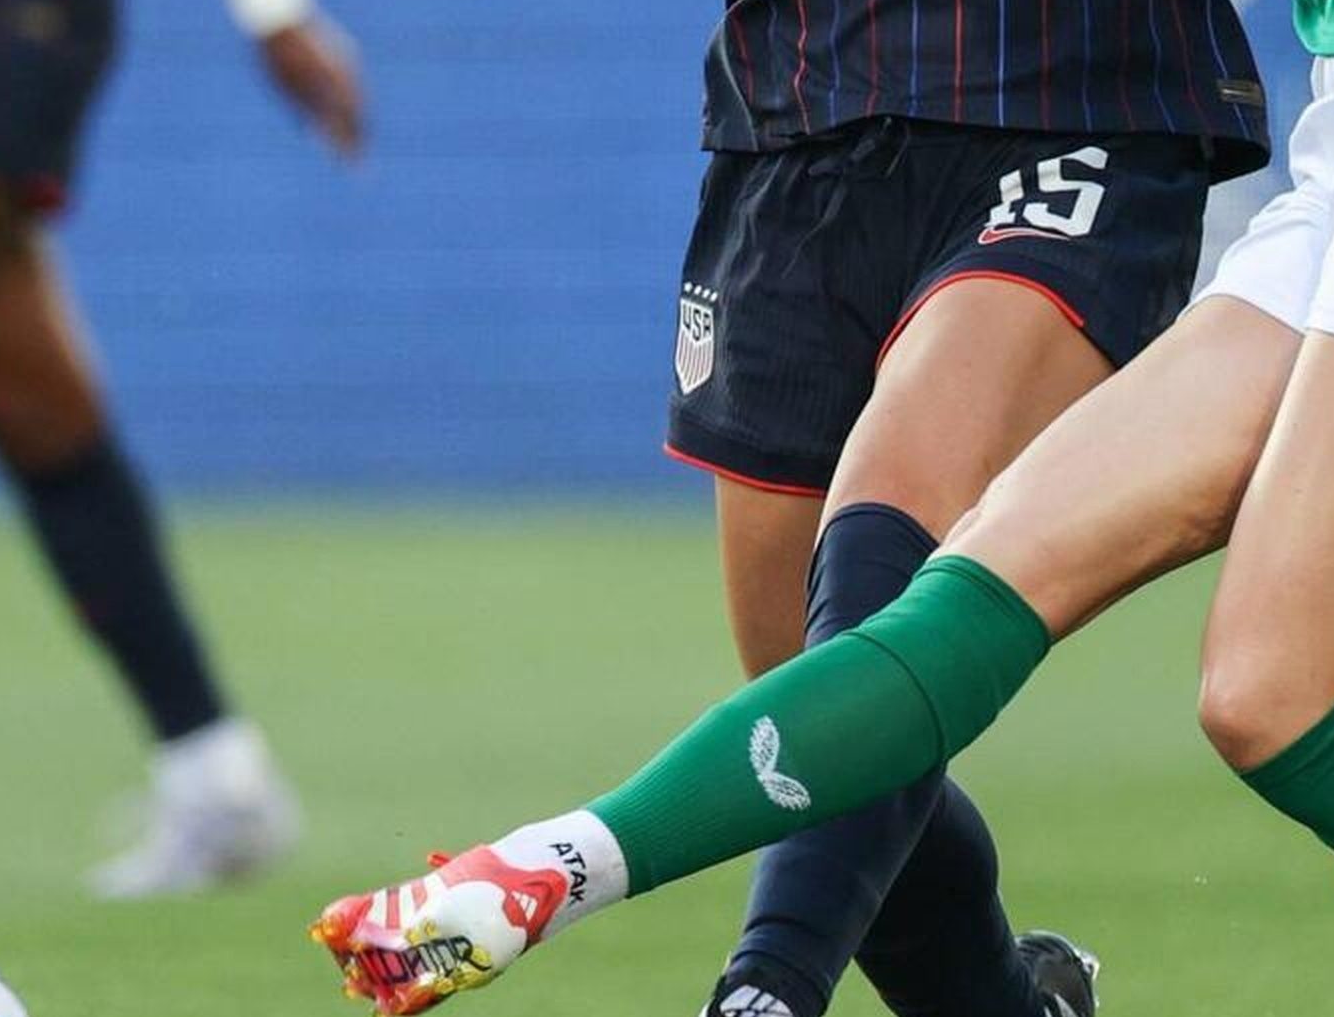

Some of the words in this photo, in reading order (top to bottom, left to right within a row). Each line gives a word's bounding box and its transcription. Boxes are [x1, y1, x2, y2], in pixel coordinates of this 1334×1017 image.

[984, 146, 1108, 236] 15
[683, 303, 712, 341] USA
[548, 841, 588, 905] ATAK
